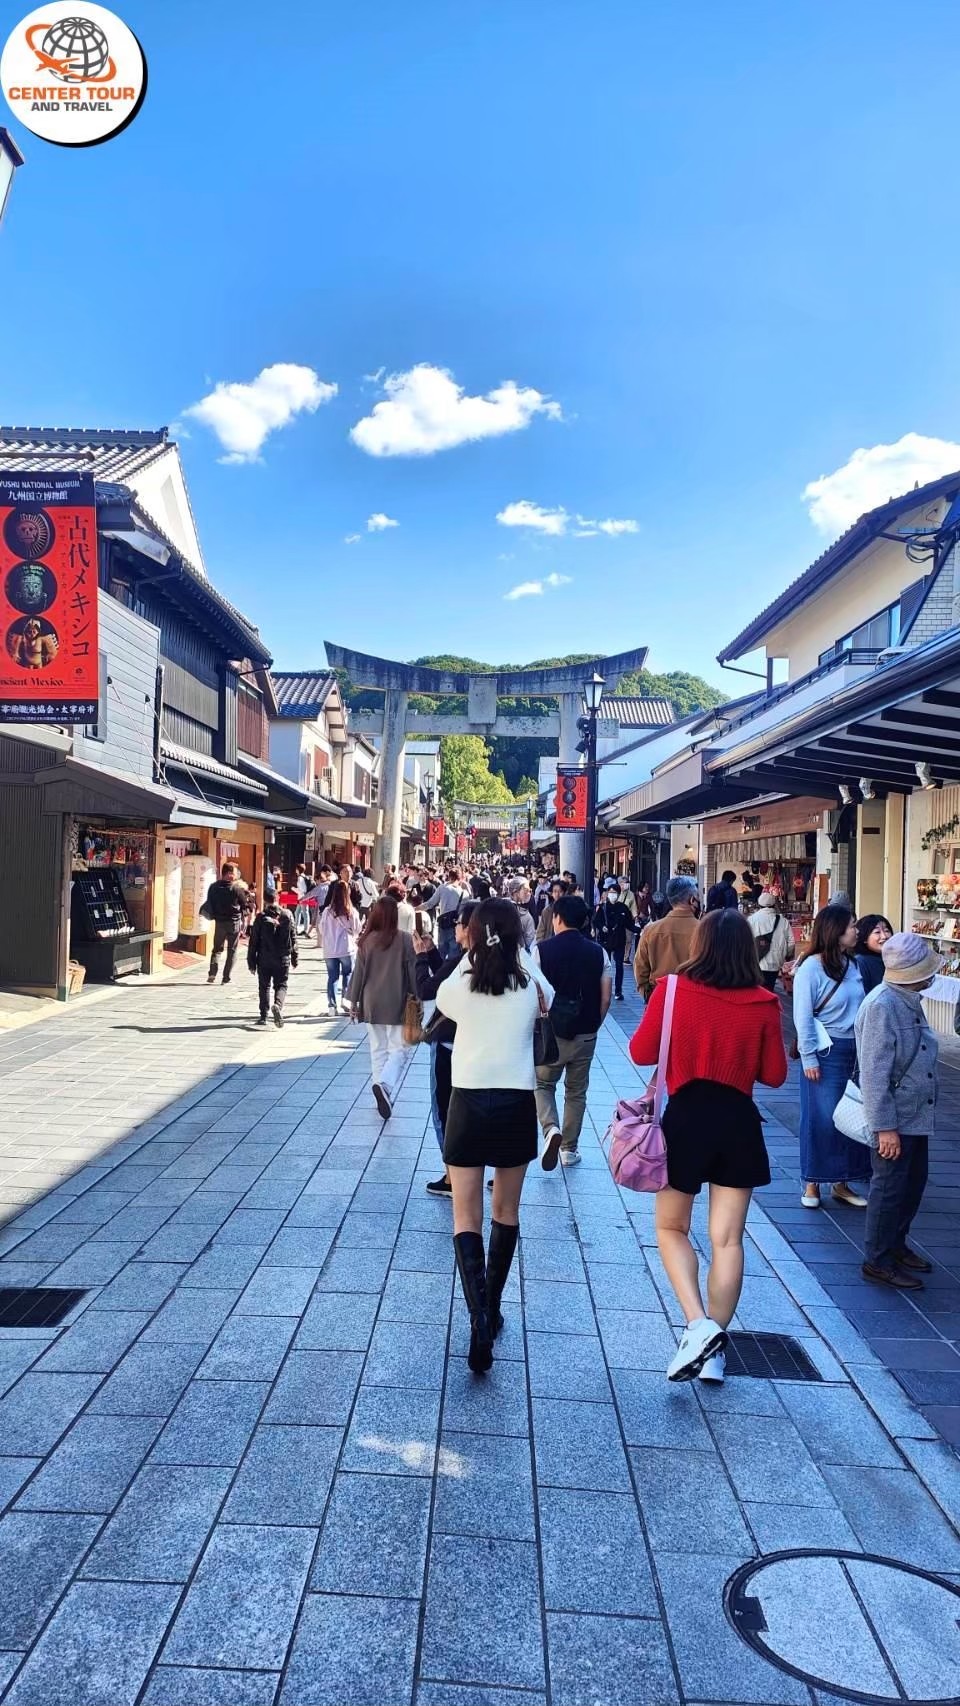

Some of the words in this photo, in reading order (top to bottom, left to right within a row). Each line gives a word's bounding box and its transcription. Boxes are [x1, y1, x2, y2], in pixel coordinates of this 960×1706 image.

[22, 481, 54, 489] NATIONAL
[55, 480, 80, 488] MUSEUM
[8, 490, 68, 501] 九州国立博物館
[69, 515, 91, 657] 古代メキシコ
[31, 677, 64, 687] Mexico
